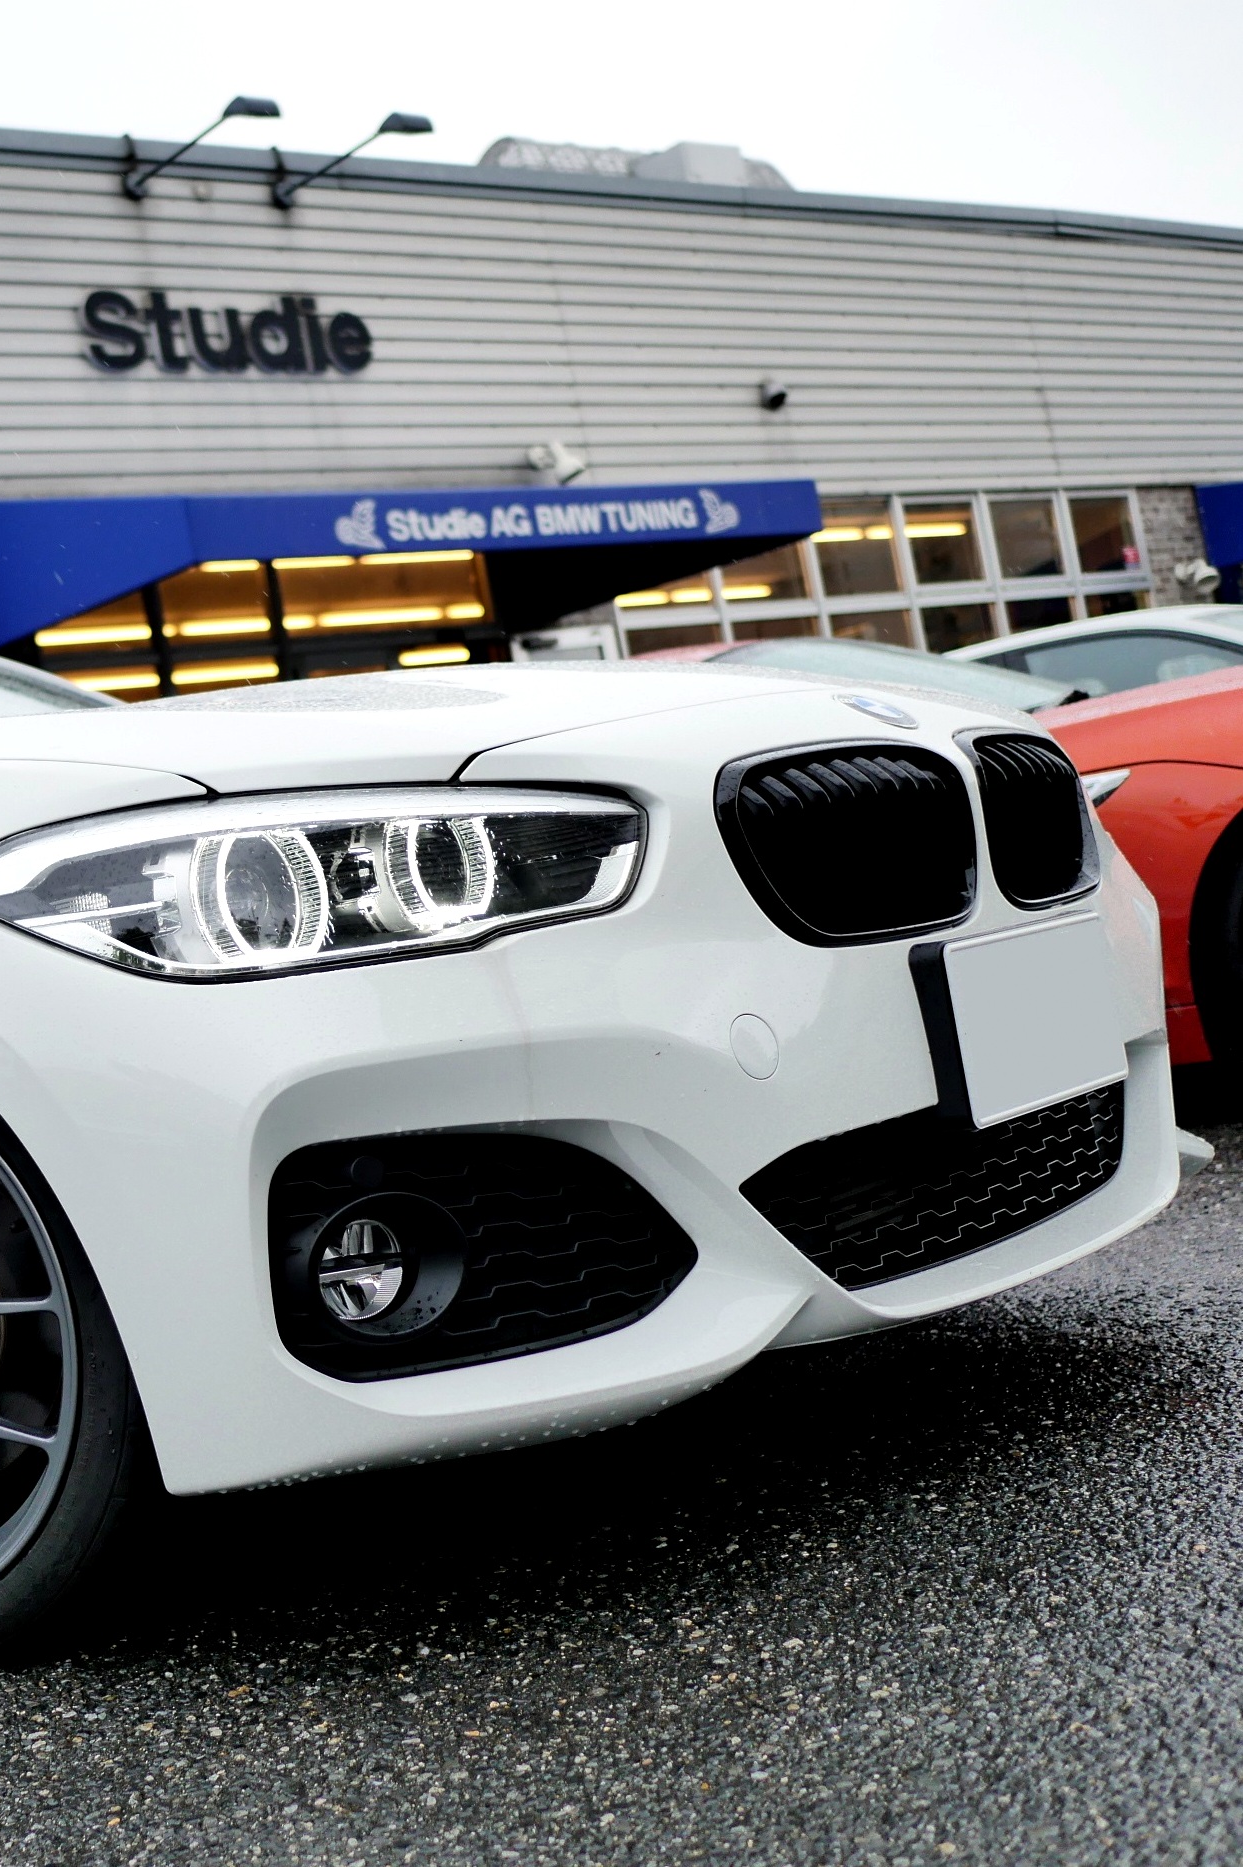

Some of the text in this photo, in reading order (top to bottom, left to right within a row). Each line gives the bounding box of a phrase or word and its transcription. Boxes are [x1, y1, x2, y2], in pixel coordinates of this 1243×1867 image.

[79, 290, 372, 374] Studie
[385, 498, 699, 542] Studie AG BMW TUNING
